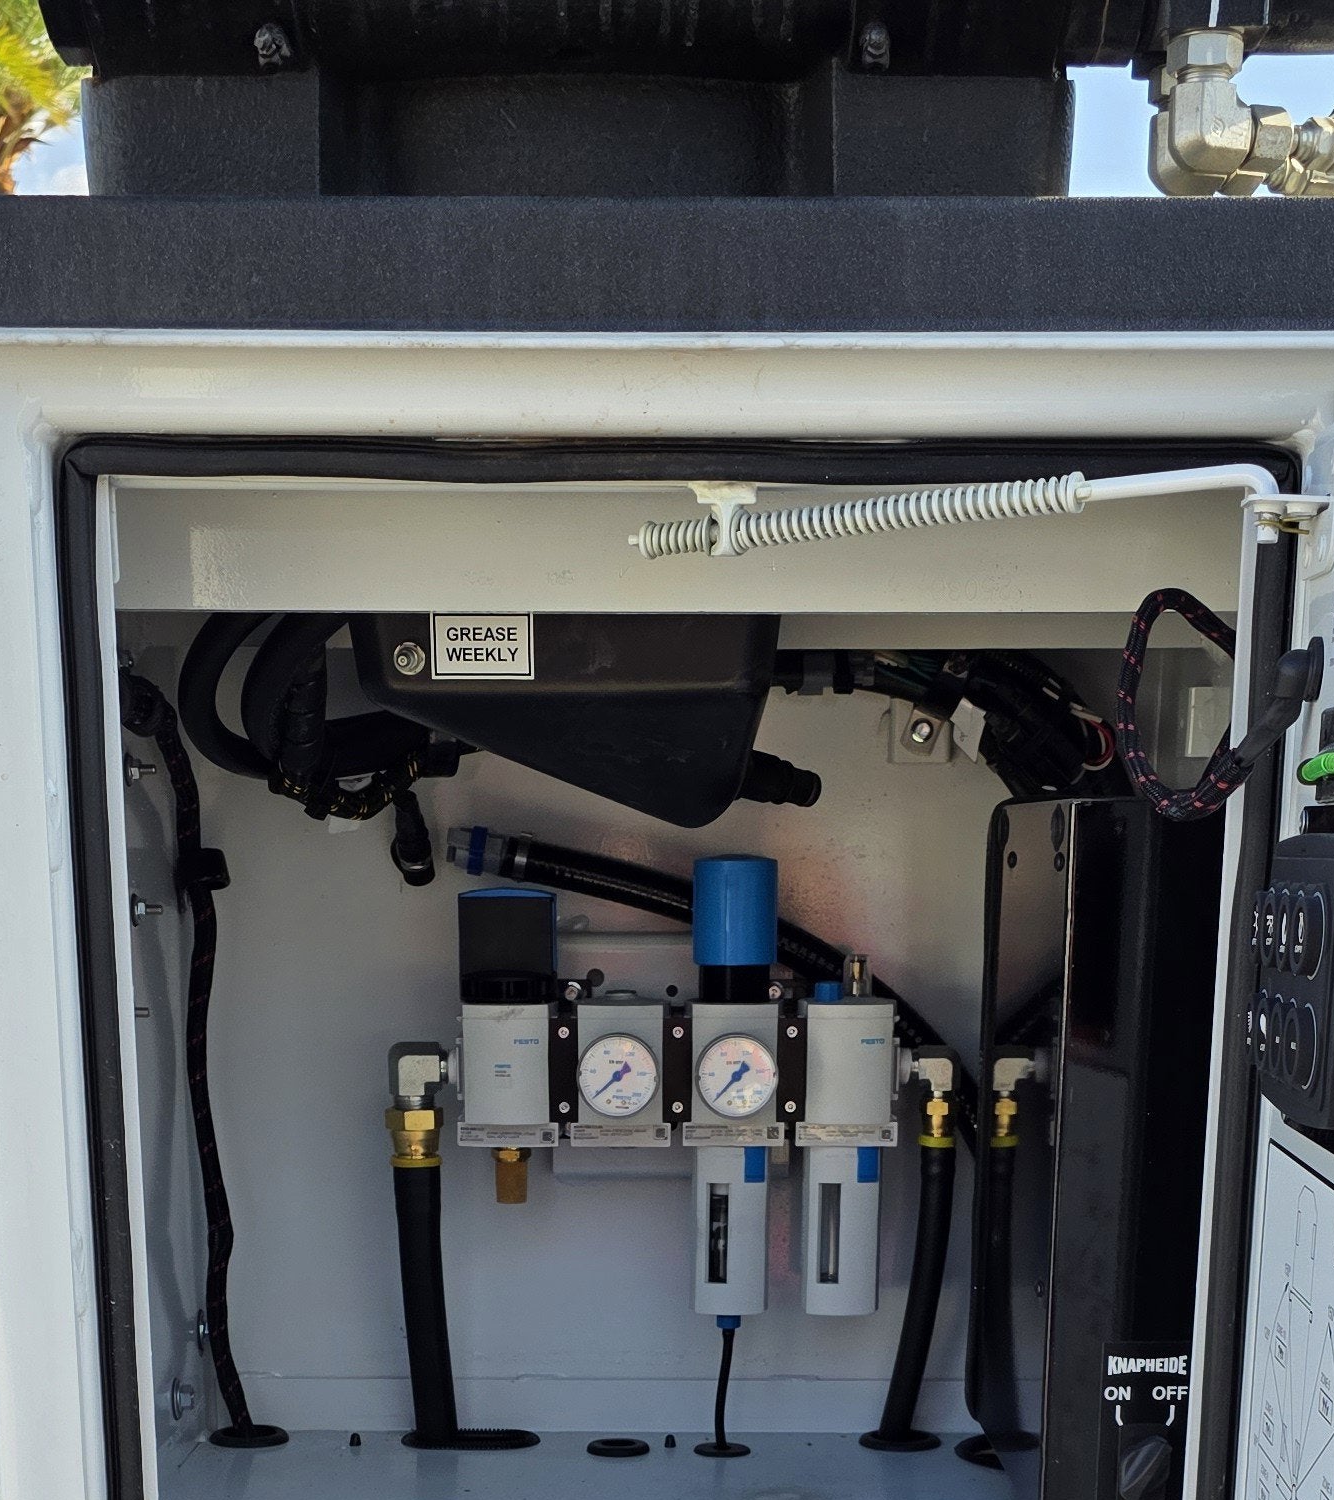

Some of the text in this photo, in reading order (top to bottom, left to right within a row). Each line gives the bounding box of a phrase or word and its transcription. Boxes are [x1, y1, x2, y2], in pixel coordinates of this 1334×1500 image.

[446, 627, 518, 642] GREASE
[446, 647, 518, 662] WEEKLY
[1107, 1355, 1188, 1376] KNAPHEIDE
[1103, 1386, 1188, 1401] ON OFF
